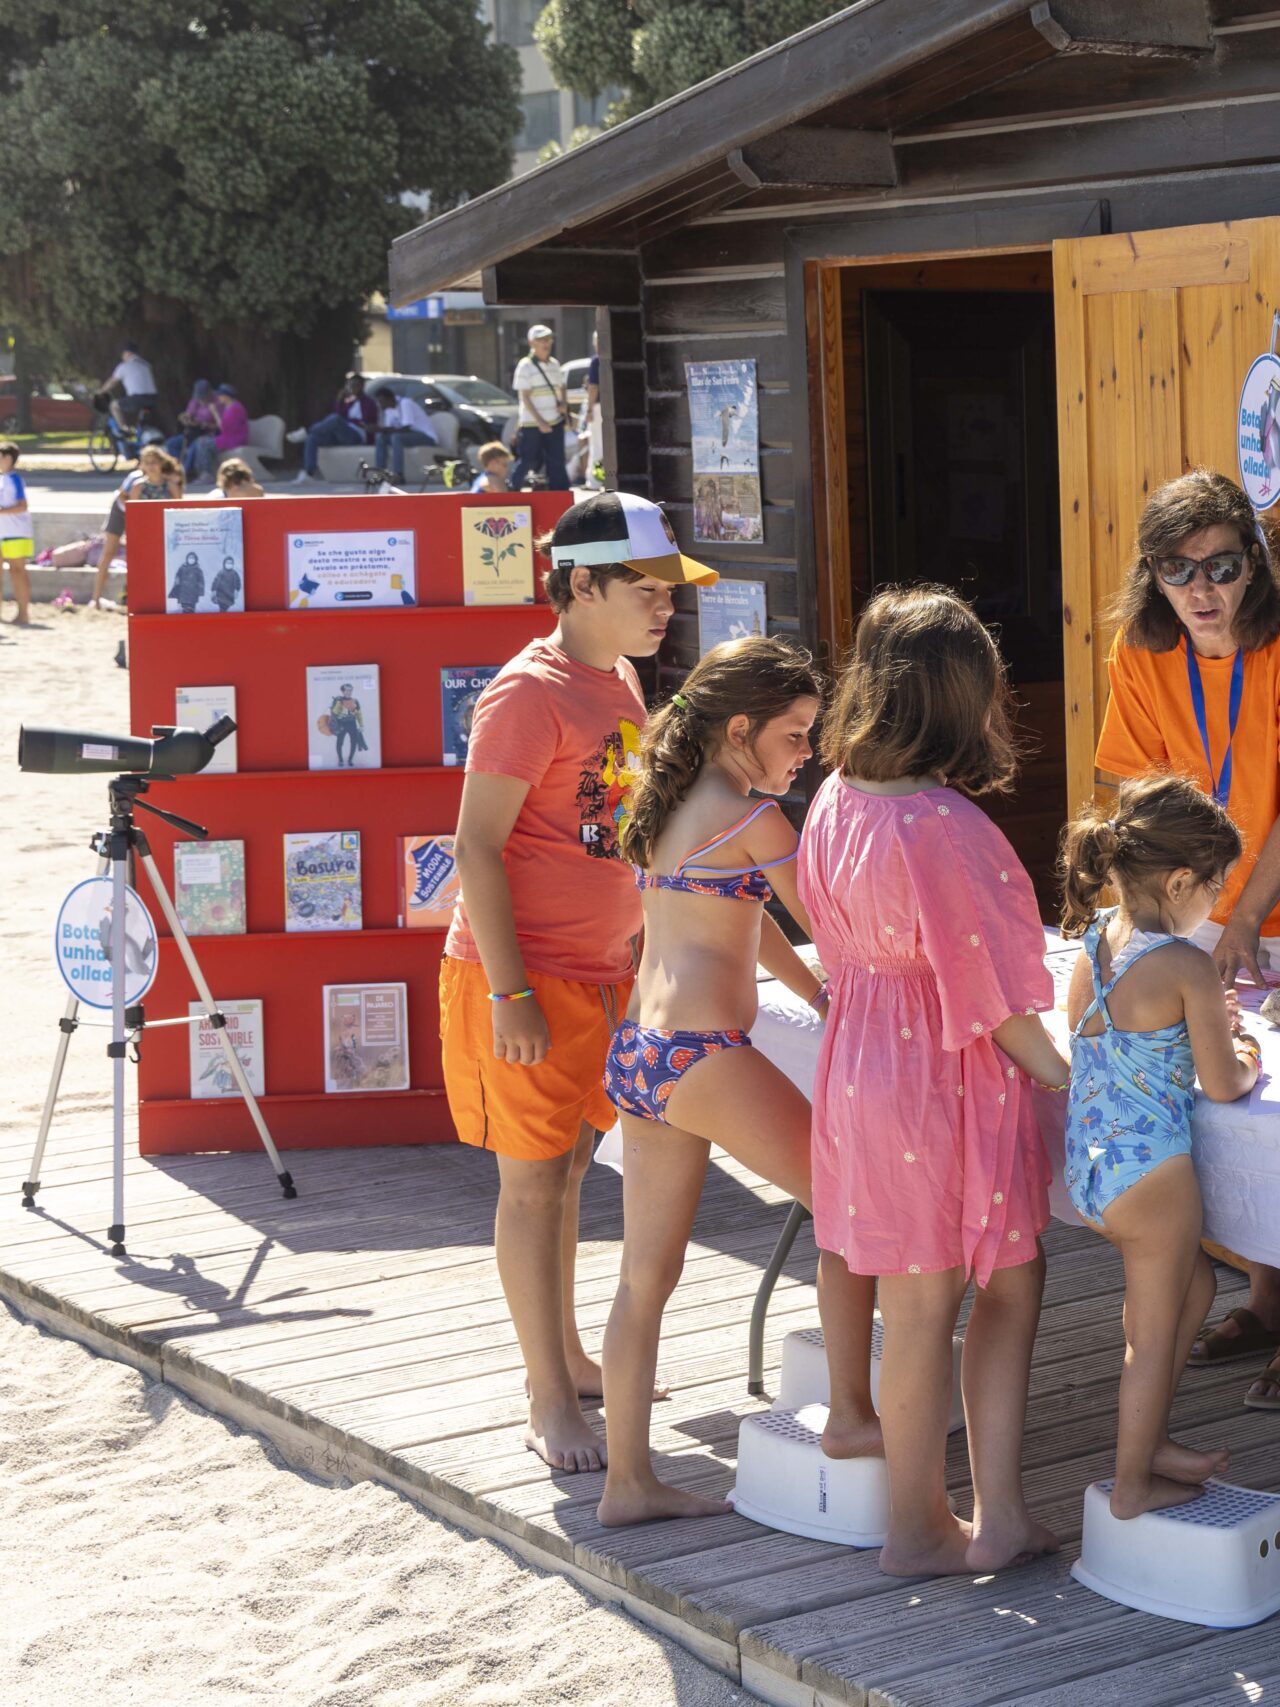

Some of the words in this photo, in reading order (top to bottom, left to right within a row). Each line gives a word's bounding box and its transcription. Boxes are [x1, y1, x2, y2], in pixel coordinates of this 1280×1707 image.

[1241, 408, 1262, 426] Bota
[1241, 434, 1263, 451] unha
[1243, 456, 1271, 479] ollada
[445, 679, 466, 688] OUR
[470, 678, 491, 688] CHO
[296, 860, 356, 876] Basura
[422, 853, 443, 879] MODA
[420, 858, 452, 898] SOSTENIBLE
[62, 924, 101, 940] Bota
[63, 945, 106, 961] unha
[71, 965, 113, 982] ollad
[199, 1031, 254, 1046] SOSNIBLE
